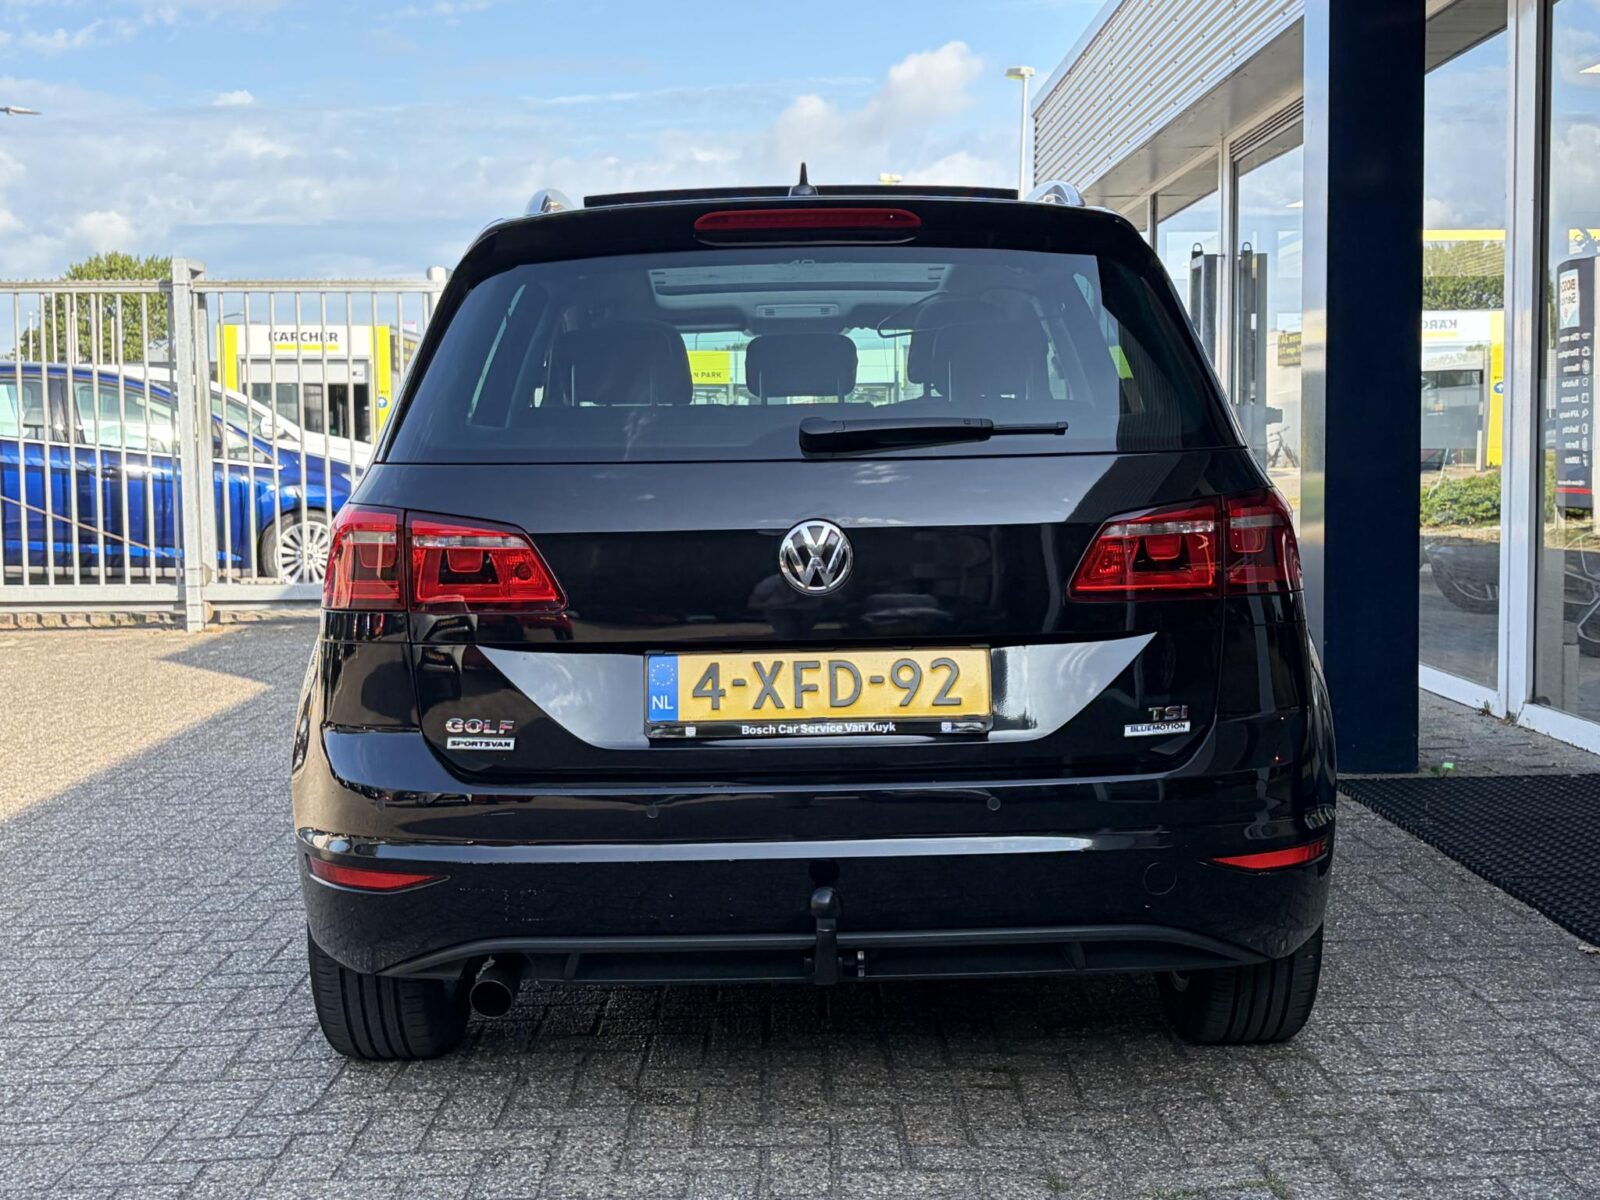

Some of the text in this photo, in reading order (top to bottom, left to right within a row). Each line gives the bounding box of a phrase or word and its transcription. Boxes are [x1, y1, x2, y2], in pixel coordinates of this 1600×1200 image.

[692, 656, 962, 710] 4-XFD-92
[651, 695, 674, 710] NL
[1148, 705, 1188, 721] TSI
[445, 717, 515, 734] GOLF
[741, 722, 896, 735] Bosch Car Service Van Kuyk
[1130, 722, 1186, 733] BLUEMOTION
[450, 740, 511, 748] SPORTSVAN
